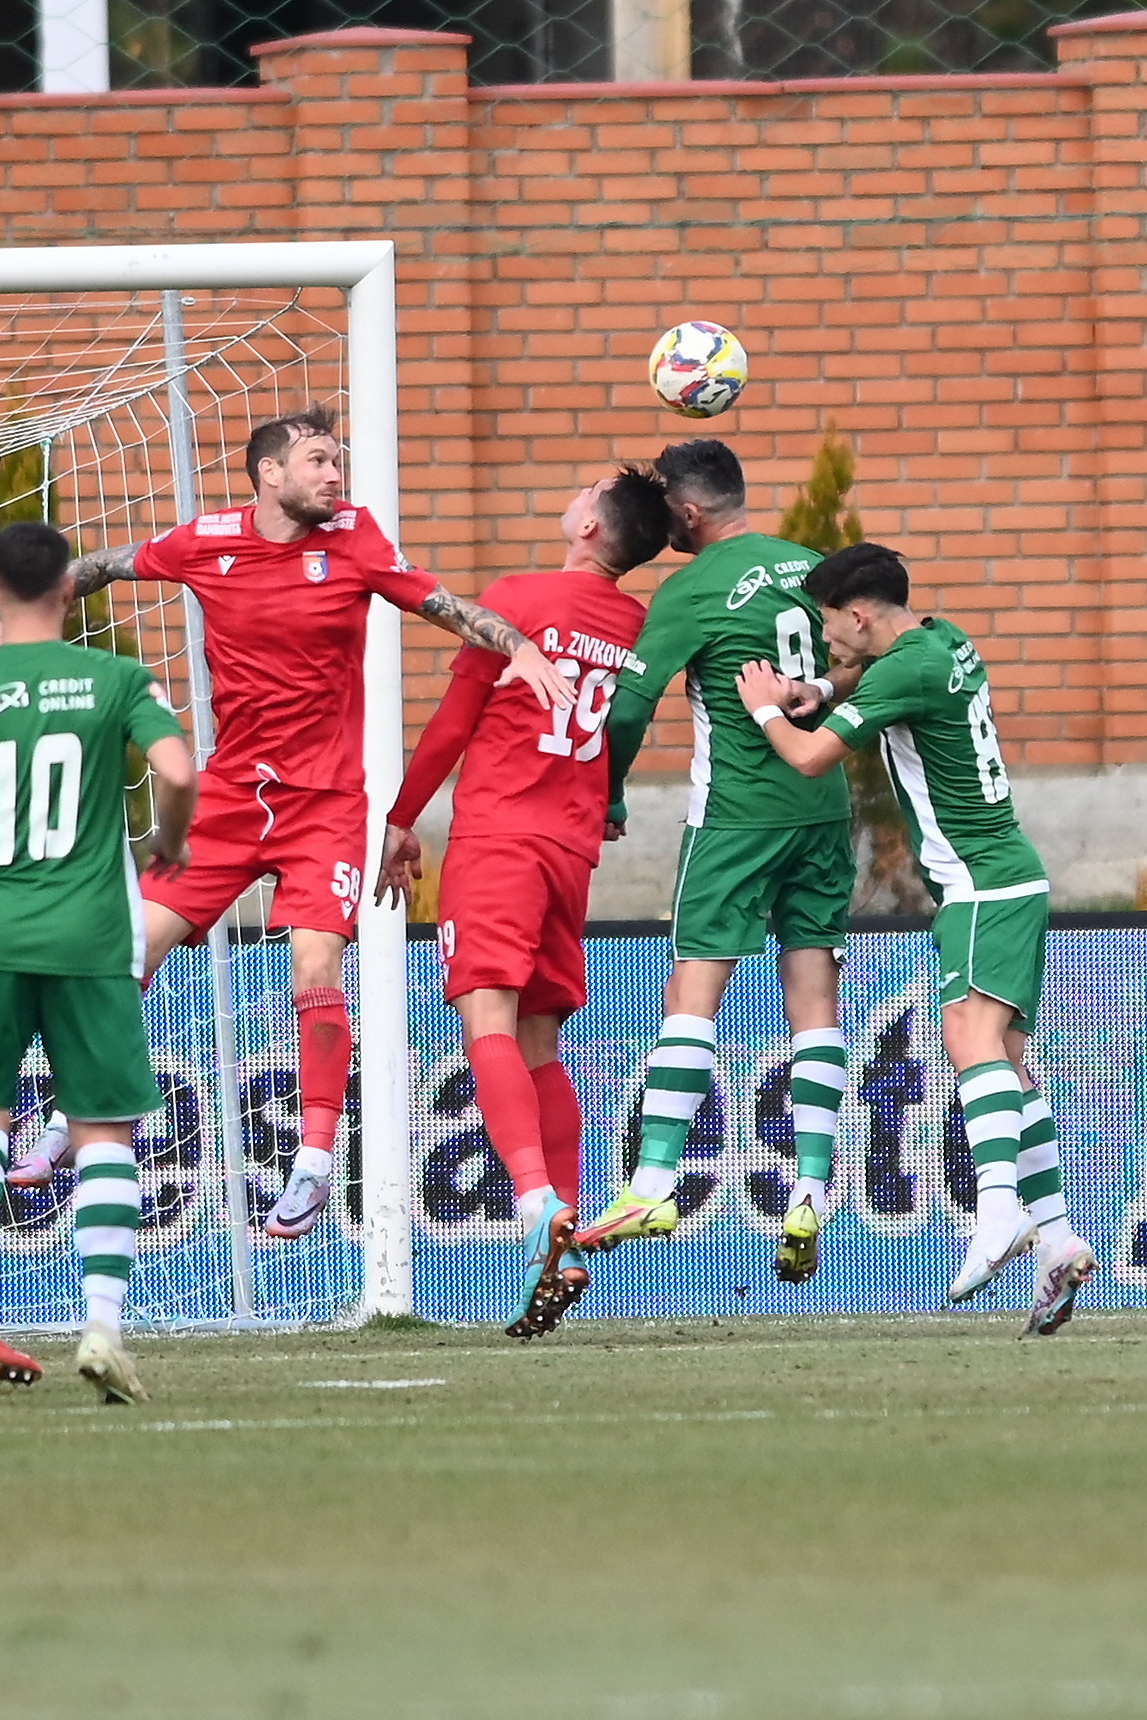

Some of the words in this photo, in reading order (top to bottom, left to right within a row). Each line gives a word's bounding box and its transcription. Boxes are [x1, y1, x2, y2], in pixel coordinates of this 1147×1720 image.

[774, 560, 811, 575] CREDIT
[543, 627, 564, 653] A.
[775, 606, 816, 685] 9
[37, 677, 95, 696] CREDIT
[37, 693, 96, 714] ONLINE
[537, 657, 618, 763] 19
[967, 680, 1011, 805] 8
[330, 860, 361, 904] 58
